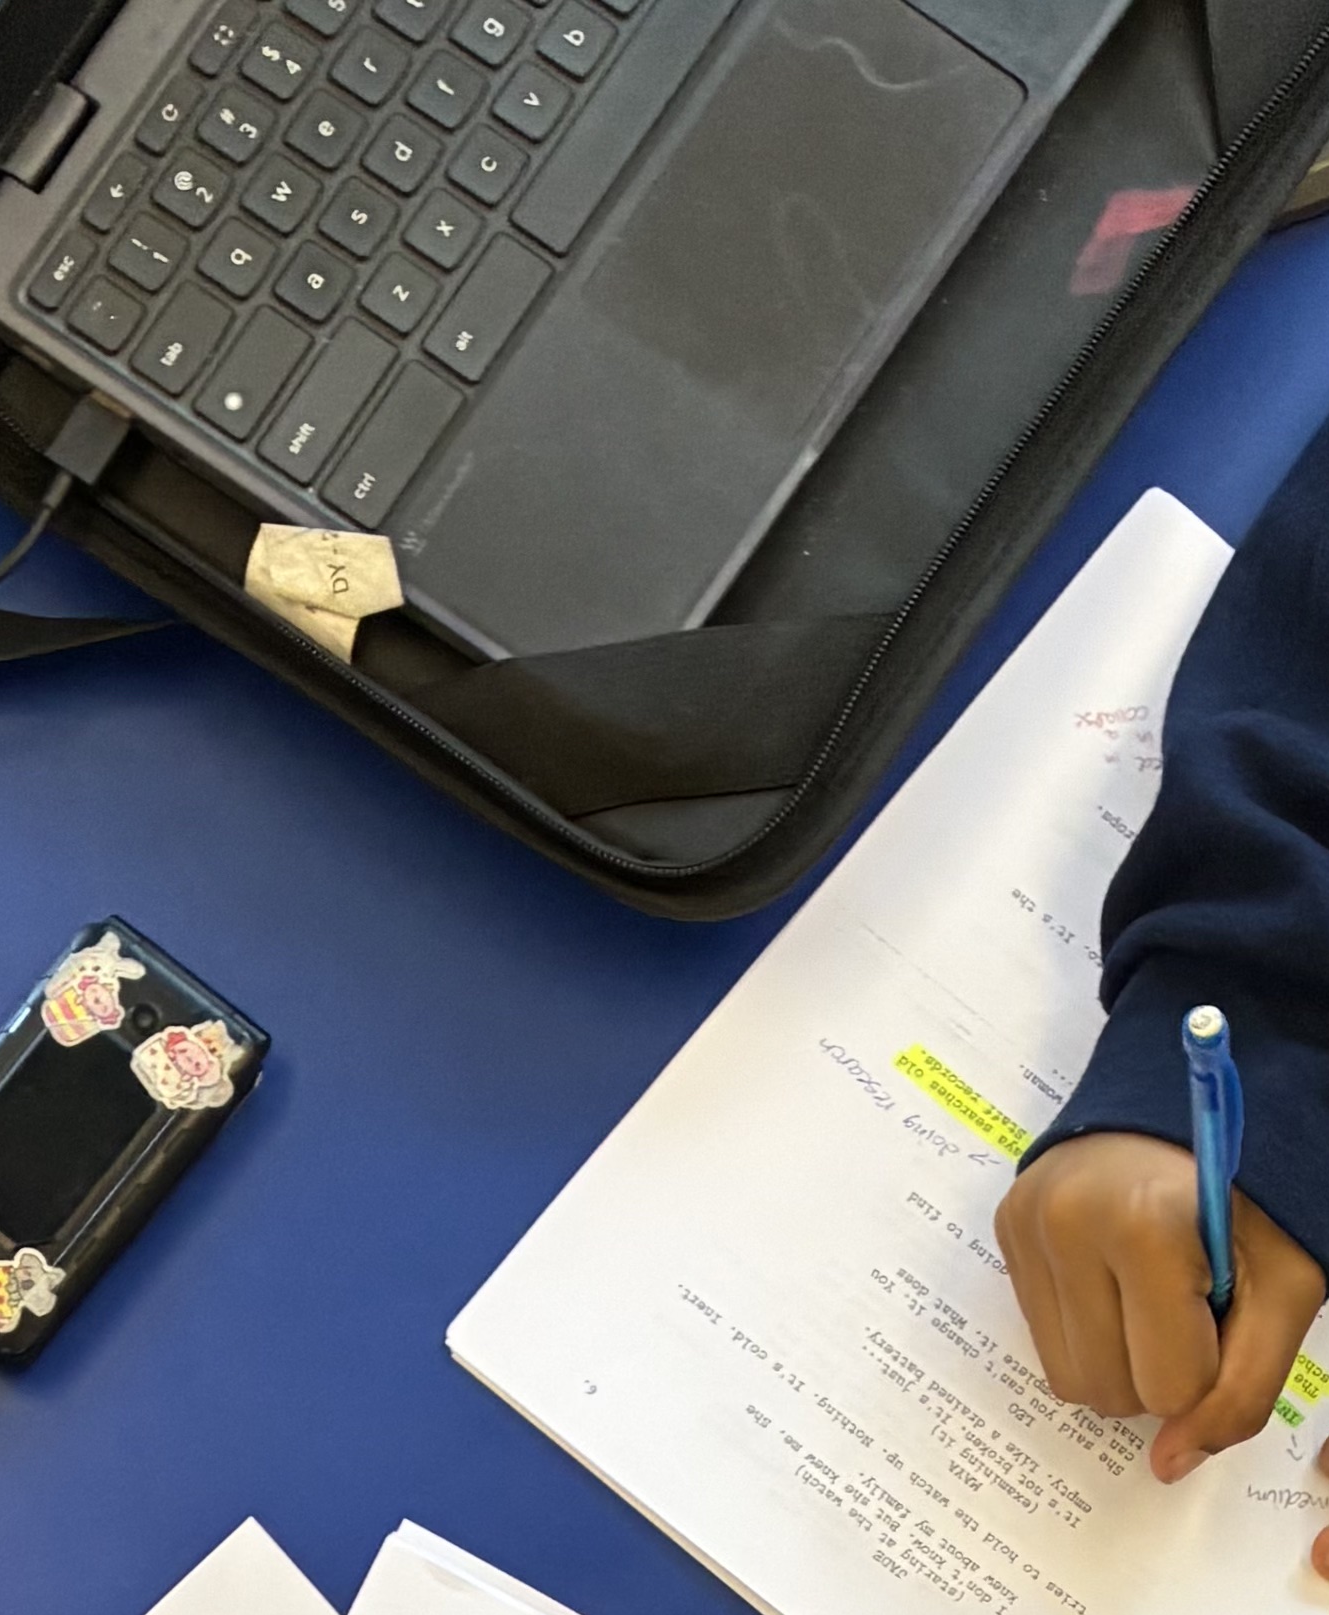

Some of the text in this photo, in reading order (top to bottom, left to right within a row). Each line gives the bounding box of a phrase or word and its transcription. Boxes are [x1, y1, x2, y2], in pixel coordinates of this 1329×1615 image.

[483, 17, 505, 37] g
[563, 29, 585, 46] b
[318, 120, 335, 137] e
[394, 141, 413, 162] d
[481, 156, 498, 172] c
[271, 181, 292, 202] w
[350, 209, 368, 225] s
[436, 220, 454, 237] x
[53, 255, 75, 281] esc
[307, 273, 325, 290] a
[392, 284, 410, 302] z
[455, 331, 474, 351] alt
[160, 342, 183, 366] tab
[288, 422, 316, 455] shift
[354, 472, 376, 499] ctrl
[895, 1055, 993, 1132] searches old
[920, 1050, 1027, 1140] Staff records.
[1019, 1064, 1063, 1104] woman.
[906, 1191, 942, 1221] find
[946, 1222, 963, 1239] to
[1293, 1373, 1319, 1398] The
[1007, 1402, 1035, 1427] LEO
[930, 1424, 1038, 1514] (examining it)
[948, 1459, 983, 1491] MAYA
[745, 1404, 1007, 1615] I don't know. But she knew me. She
[794, 1464, 965, 1601] (staring at the watch)
[871, 1549, 908, 1579] JADE
